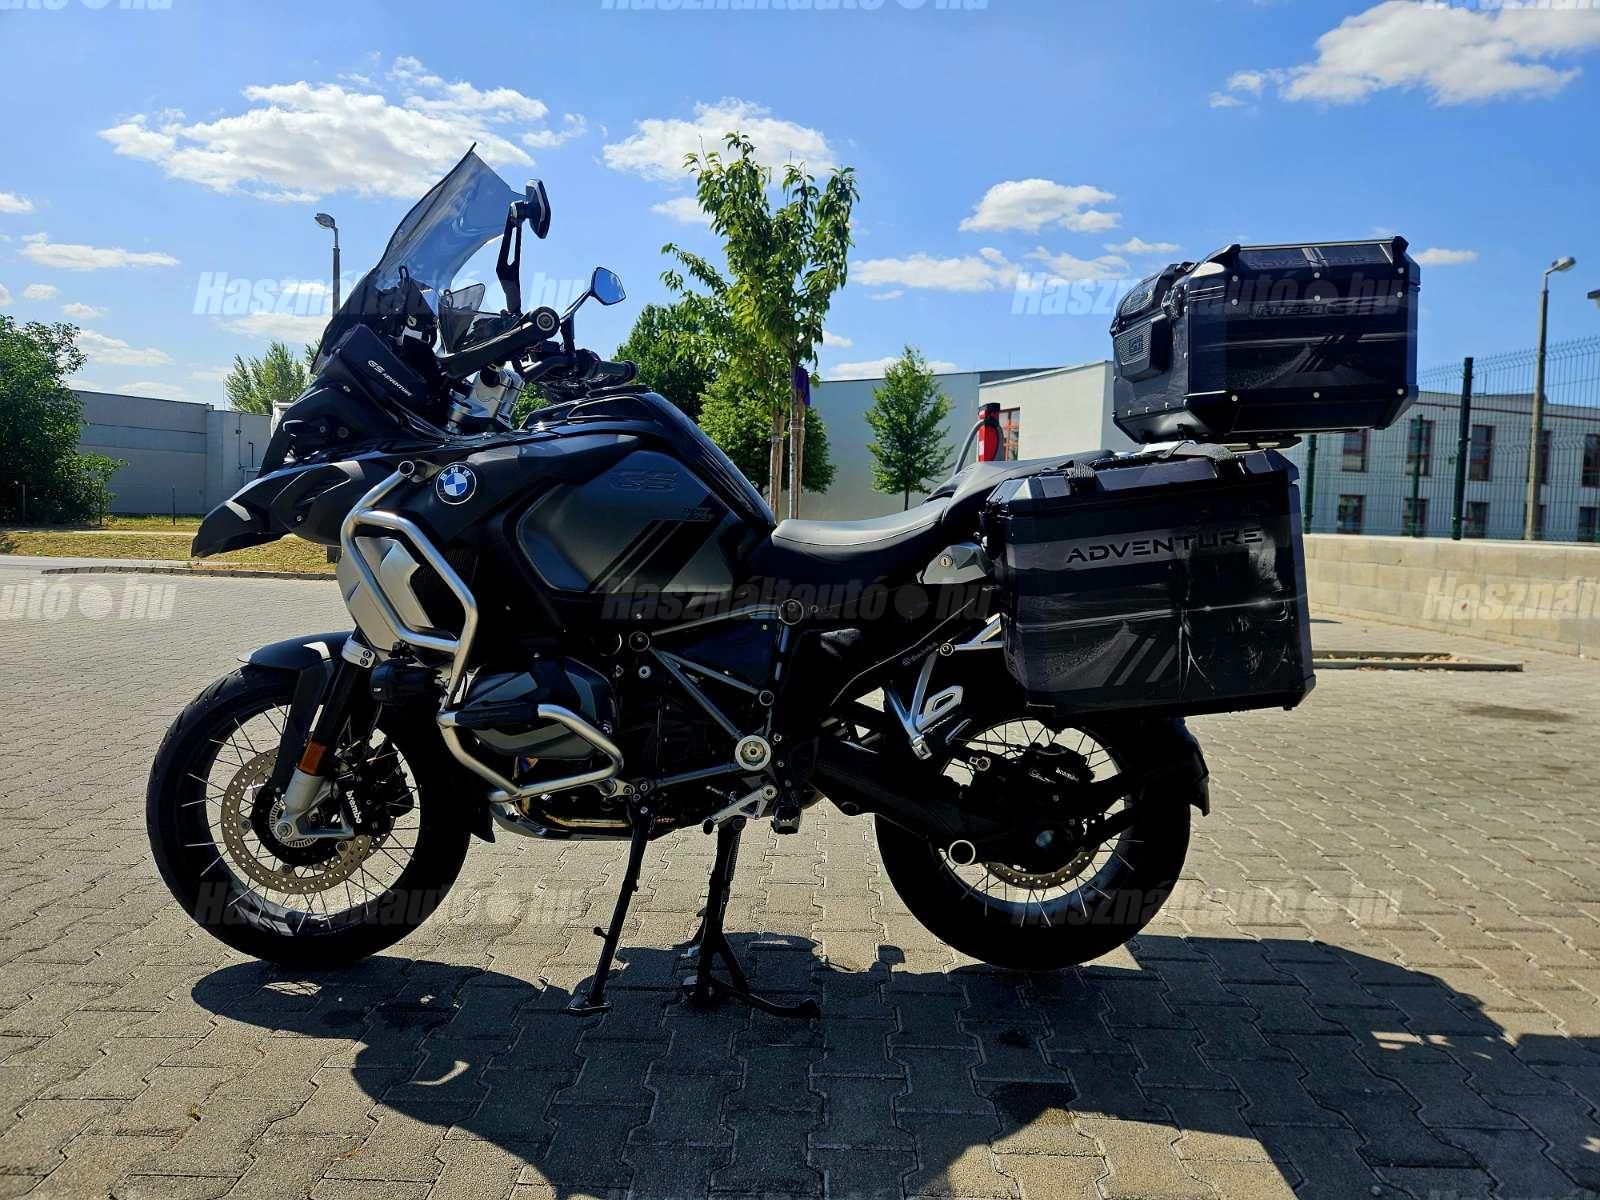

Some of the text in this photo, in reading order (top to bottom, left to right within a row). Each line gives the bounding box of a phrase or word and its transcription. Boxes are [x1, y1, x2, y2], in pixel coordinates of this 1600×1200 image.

[367, 359, 386, 374] GS
[1066, 527, 1263, 564] ADVENTURE
[345, 789, 363, 824] brembo
